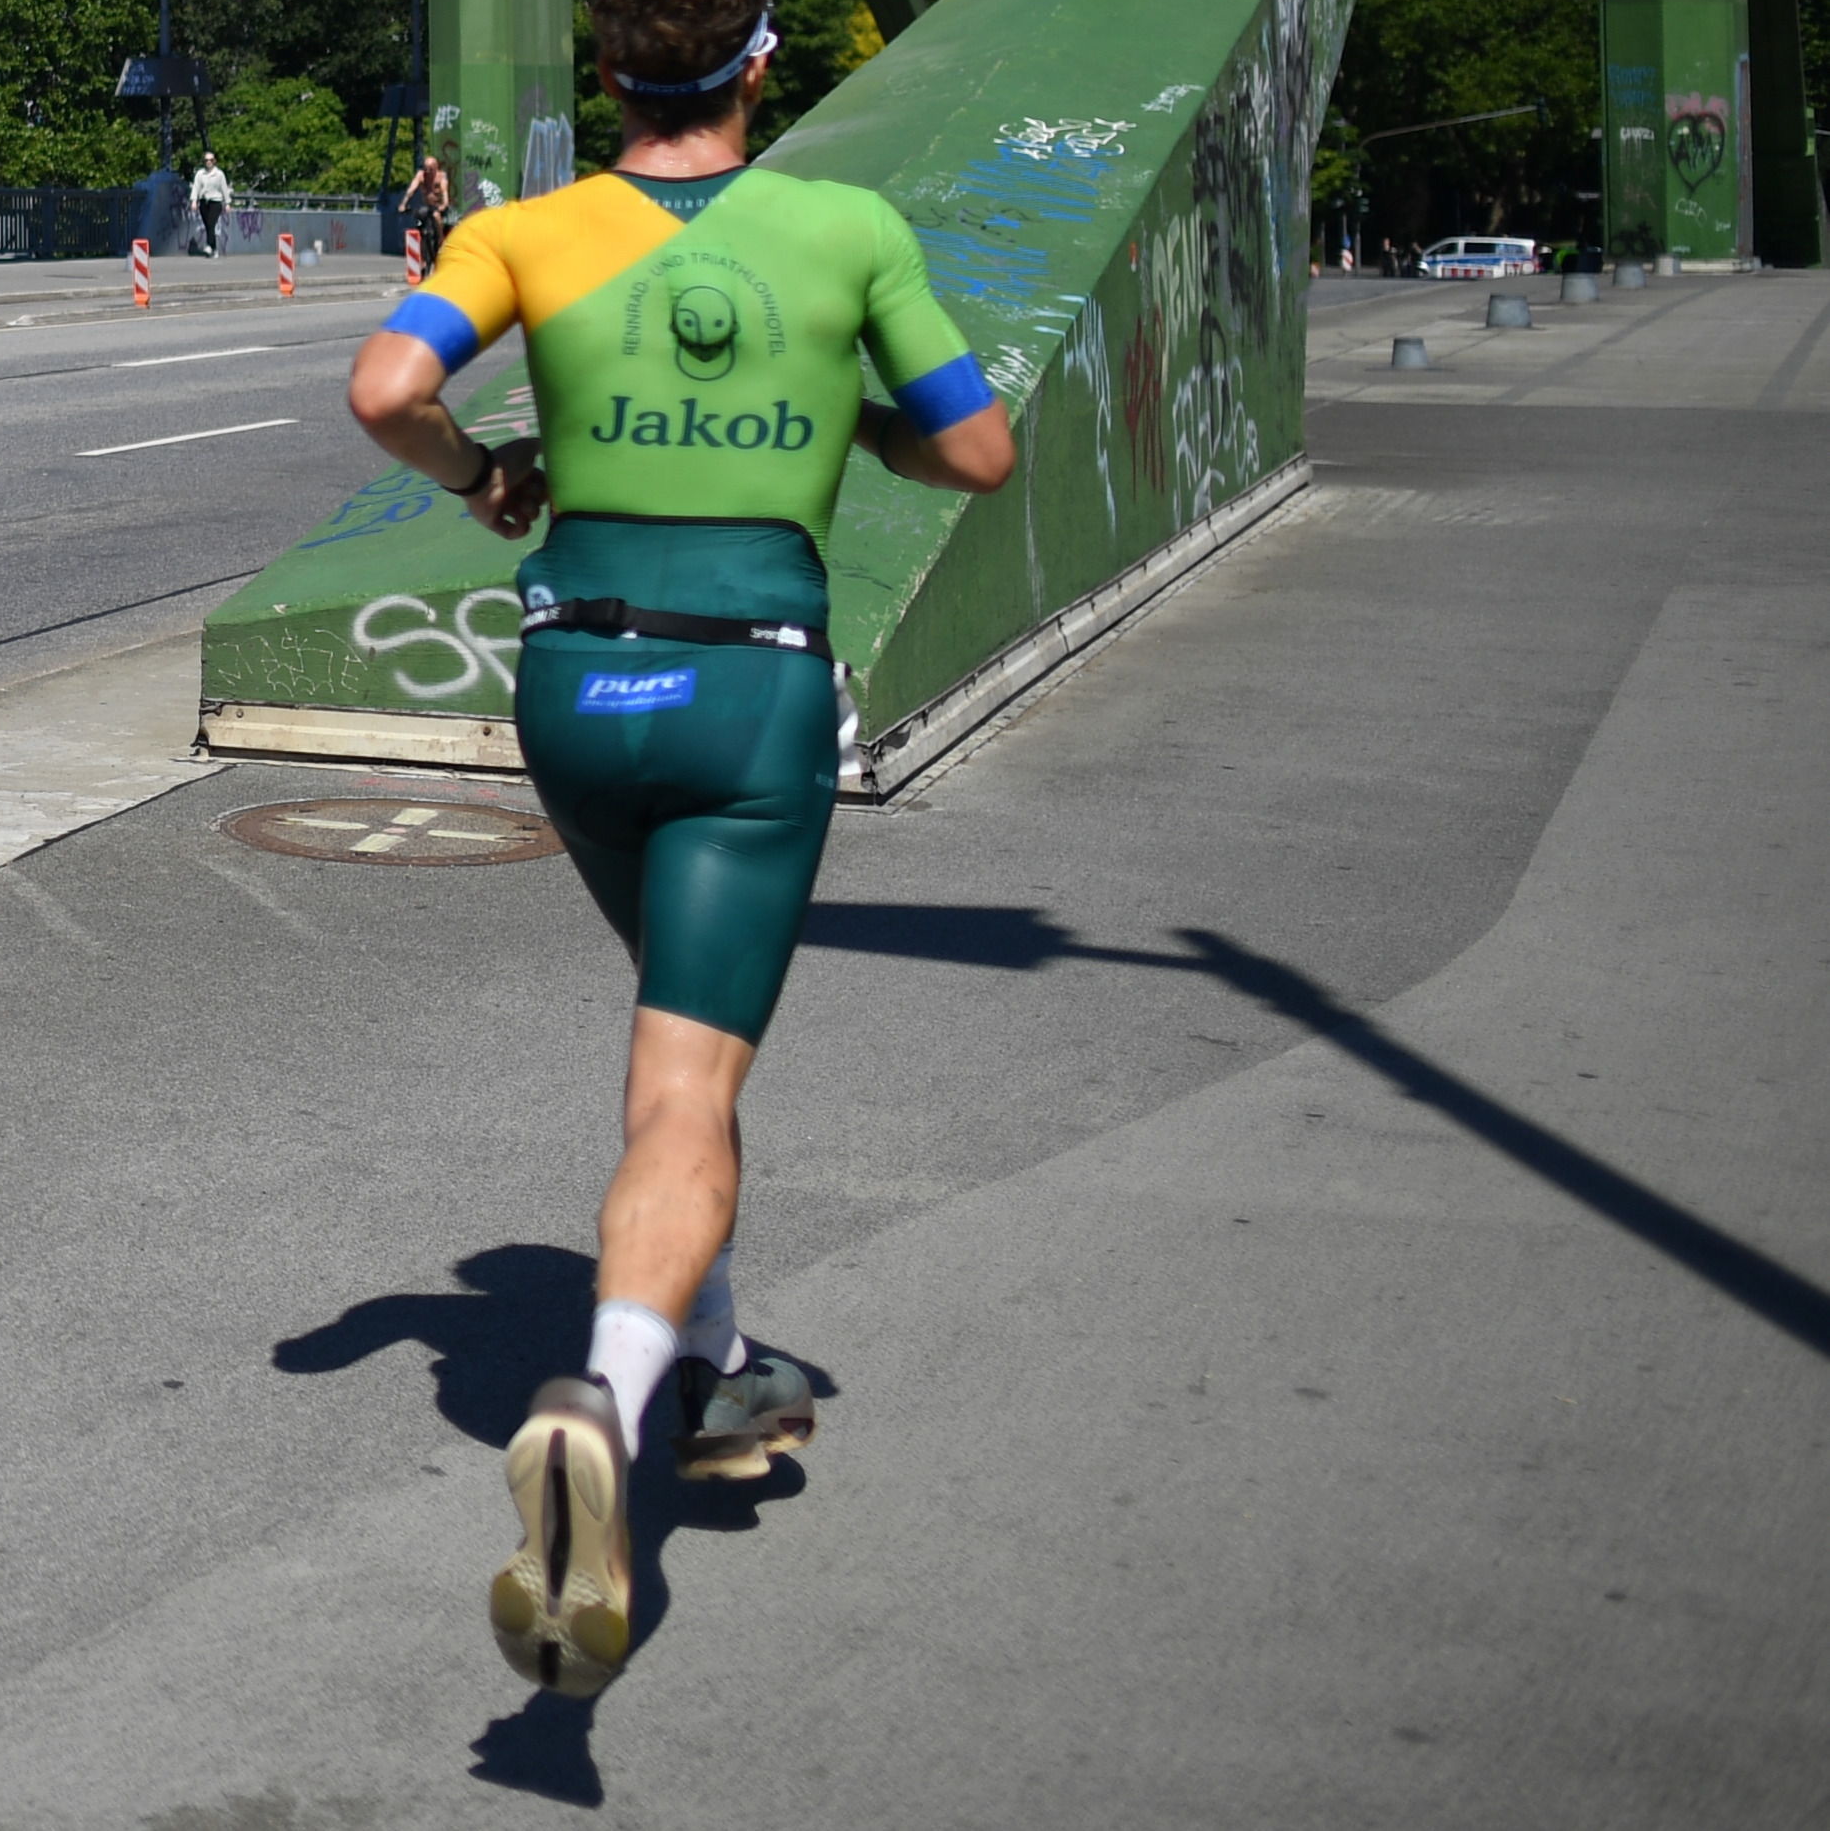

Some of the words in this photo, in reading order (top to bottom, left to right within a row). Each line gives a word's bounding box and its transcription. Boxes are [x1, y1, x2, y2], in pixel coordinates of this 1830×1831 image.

[651, 253, 686, 276] UND
[591, 395, 814, 452] Jakob
[586, 675, 688, 699] pure
